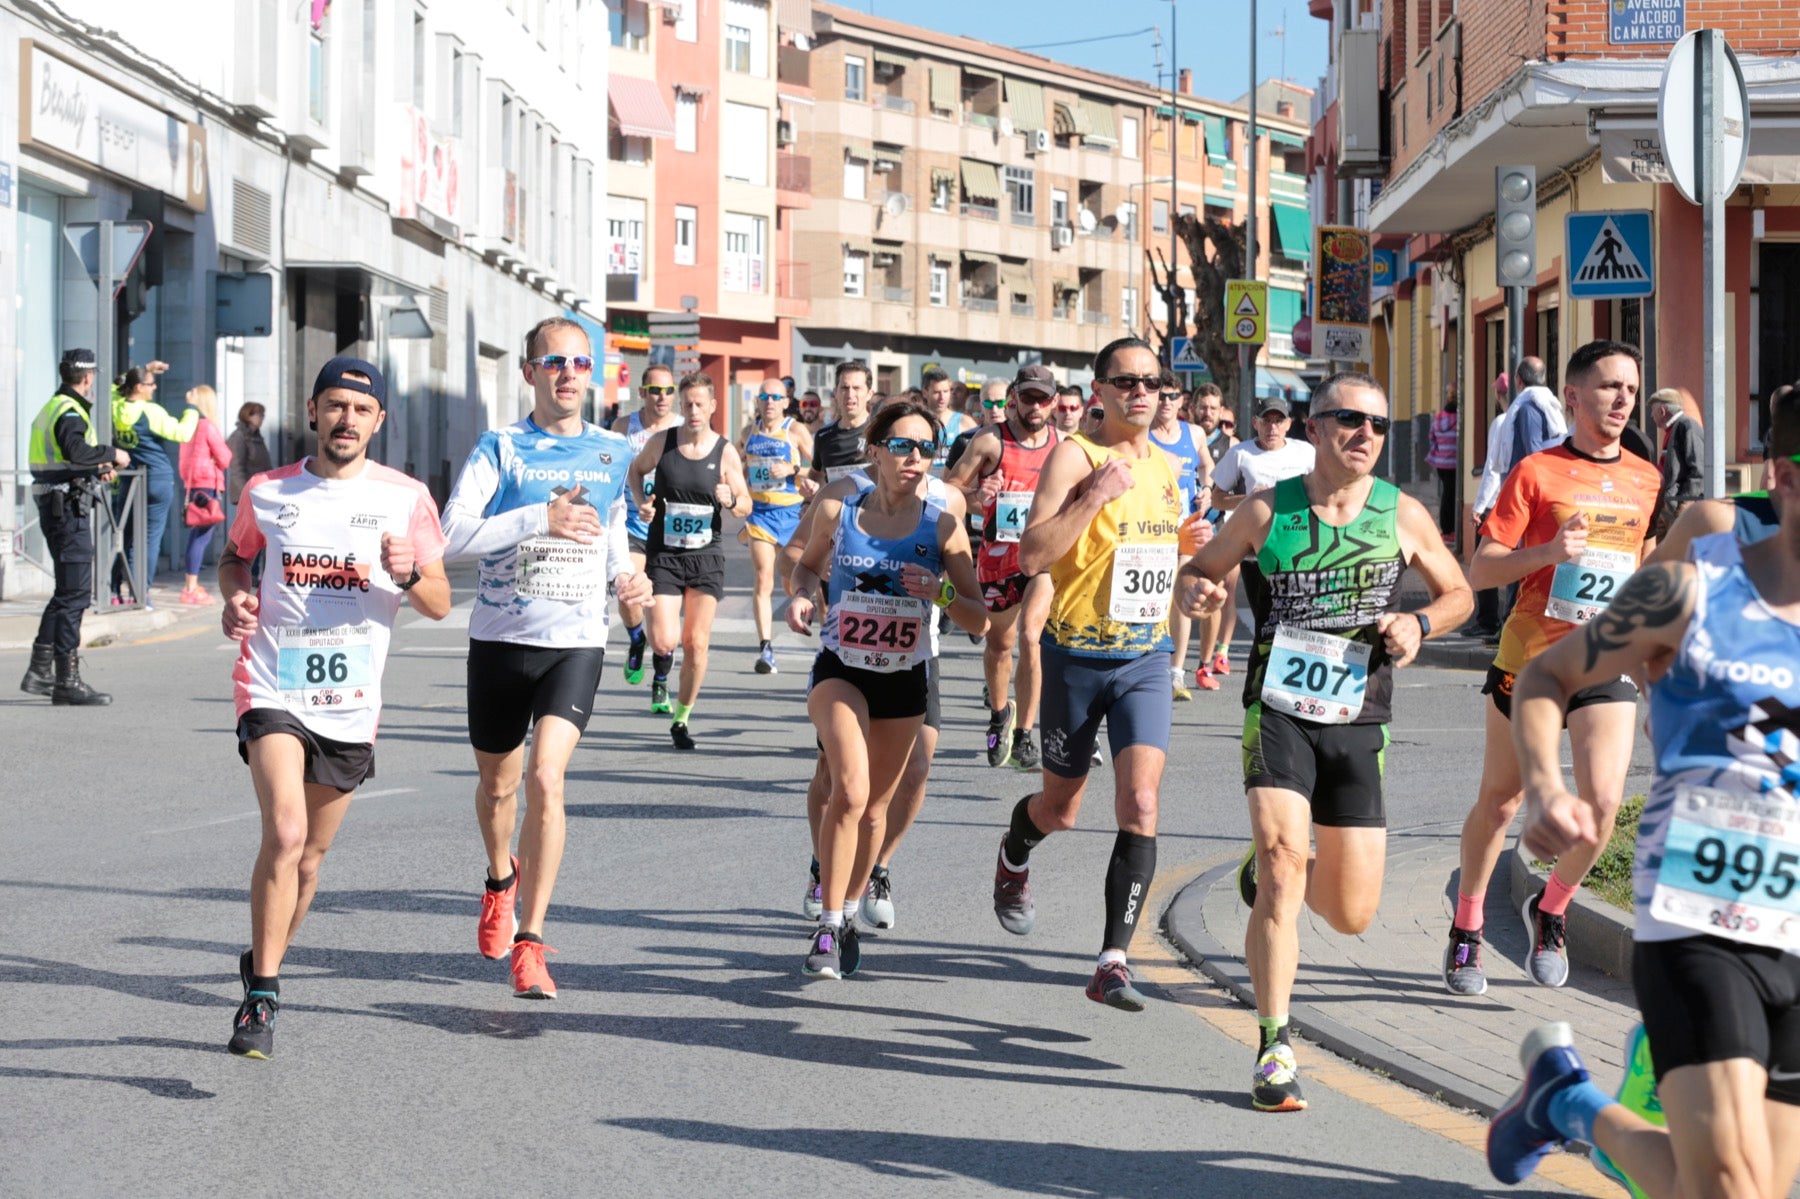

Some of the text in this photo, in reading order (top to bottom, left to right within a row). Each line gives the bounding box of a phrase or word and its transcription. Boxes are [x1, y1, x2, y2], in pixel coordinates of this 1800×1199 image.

[1627, 0, 1682, 9] AVENIDA
[1631, 10, 1677, 24] JACOBO
[1614, 25, 1681, 40] CAMARERO
[1633, 138, 1661, 149] TOL
[1240, 323, 1253, 332] 20
[527, 469, 611, 484] TODO SUMA
[672, 517, 704, 534] 852
[520, 545, 598, 555] YO CORRO CONTRA
[282, 552, 357, 572] BABOLÉ
[837, 555, 875, 568] TODO
[532, 566, 565, 576] aecc
[285, 572, 371, 593] ZURKO FC
[1123, 568, 1173, 595] 3084
[1269, 573, 1317, 598] TEAM
[861, 596, 874, 604] GRAN
[875, 597, 894, 607] PREMIO
[895, 599, 901, 607] DE
[902, 600, 917, 609] FONDO
[301, 628, 318, 637] GRAN
[319, 627, 340, 636] PREMIO
[341, 627, 348, 636] DE
[349, 626, 368, 635] FONDO
[843, 616, 917, 648] 2245
[1299, 631, 1316, 643] GRAN
[1316, 635, 1338, 648] PREMIO
[1347, 643, 1366, 655] FONDO
[306, 653, 348, 684] 86
[1282, 657, 1352, 696] 207
[1711, 660, 1794, 689] TODO
[1692, 837, 1800, 899] 995
[1124, 882, 1141, 925] SKINS
